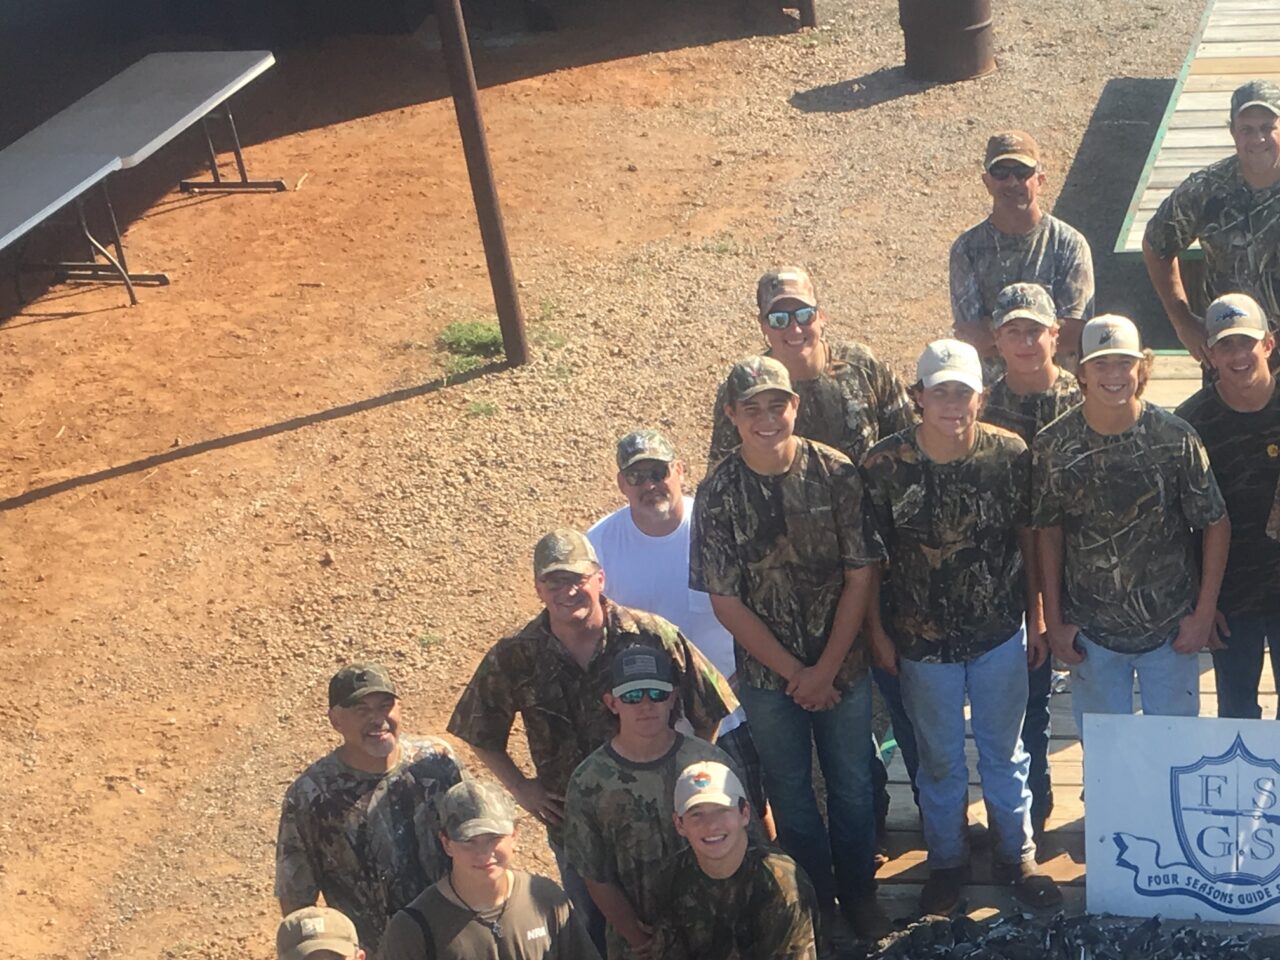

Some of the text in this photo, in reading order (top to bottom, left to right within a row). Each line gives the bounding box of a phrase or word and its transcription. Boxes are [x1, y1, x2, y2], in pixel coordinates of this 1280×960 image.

[1199, 775, 1277, 809] F S
[1197, 826, 1275, 860] G S
[1148, 874, 1179, 887] FOUR
[1185, 876, 1234, 904] SEASONS
[1237, 887, 1272, 904] GUIDE
